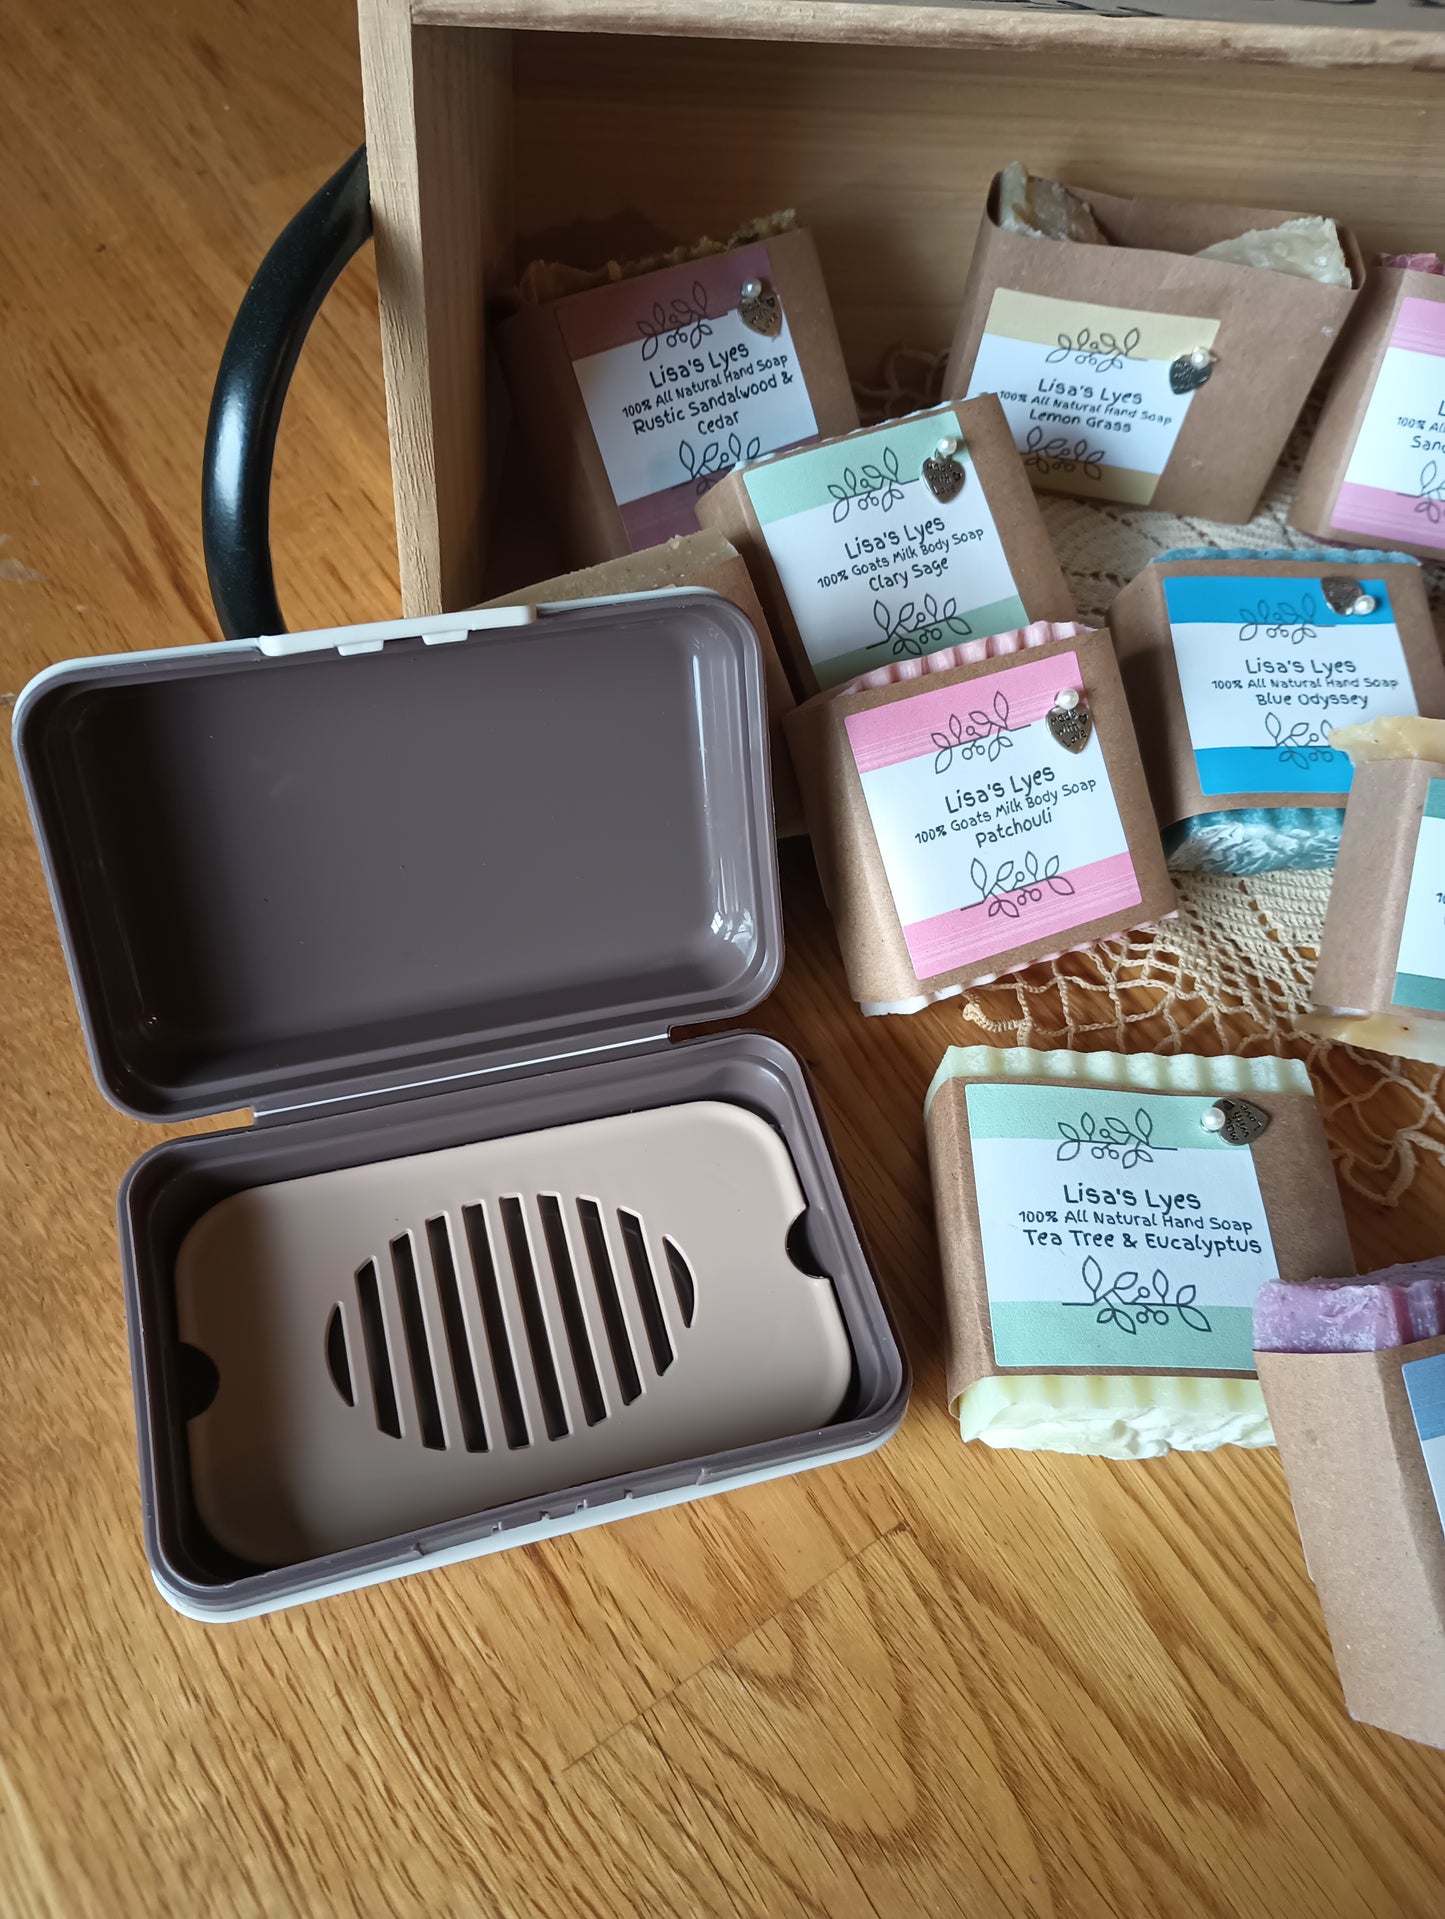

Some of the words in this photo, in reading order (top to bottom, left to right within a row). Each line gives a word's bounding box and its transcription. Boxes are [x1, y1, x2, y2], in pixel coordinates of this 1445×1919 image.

[649, 357, 705, 389] Lisa's
[708, 343, 750, 372] Lyes
[622, 398, 652, 418] 100%
[656, 389, 673, 408] All
[675, 373, 723, 400] Natural
[724, 363, 754, 384] Hand
[757, 354, 789, 372] Soap
[1038, 378, 1094, 399] Lisa's
[1100, 388, 1143, 407] Lyes
[632, 407, 686, 435] Rustic
[688, 374, 778, 417] Sandalwood
[782, 371, 794, 385] &
[1000, 390, 1028, 403] 100%
[1030, 395, 1051, 406] All
[1052, 398, 1101, 414] Natural
[1103, 405, 1137, 419] Hand
[1140, 411, 1172, 427] Soap
[697, 411, 740, 435] Cedar
[1029, 409, 1080, 425] Lemon
[1086, 416, 1132, 433] Grass
[1398, 416, 1426, 430] 100%
[844, 531, 900, 560] Lisa's
[903, 517, 945, 545] Lyes
[817, 569, 849, 589] 100%
[851, 556, 890, 576] Goats
[892, 546, 919, 564] Milk
[920, 538, 950, 556] Body
[952, 528, 984, 546] Soap
[869, 570, 909, 592] Clary
[911, 557, 949, 577] Sage
[1211, 680, 1243, 690] 100%
[1247, 678, 1267, 689] All
[1270, 678, 1322, 689] Natural
[1325, 677, 1359, 688] Hand
[1363, 678, 1399, 690] Soap
[1245, 657, 1305, 674] Lisa's
[1310, 659, 1357, 679] Lyes
[1256, 692, 1292, 706] Blue
[1297, 693, 1368, 709] Odyssey
[1063, 729, 1087, 748] Love
[945, 782, 1005, 814] Lisa's
[1010, 766, 1055, 797] Lyes
[914, 825, 947, 844] 100%
[950, 811, 992, 832] Goats
[995, 798, 1023, 818] Milk
[1025, 790, 1058, 809] Body
[1061, 779, 1097, 797] Soap
[1063, 1182, 1137, 1207] Lisa's
[1145, 1189, 1201, 1215] Lyes
[1018, 1210, 1058, 1224] 100%
[1064, 1209, 1088, 1224] All
[1093, 1210, 1158, 1227] Natural
[1162, 1213, 1204, 1230] Hand
[1209, 1217, 1253, 1235] Soap
[1022, 1229, 1062, 1247] Tea
[1068, 1229, 1114, 1247] Tree
[1122, 1232, 1138, 1249] &
[1145, 1233, 1263, 1258] Eucalyptus
